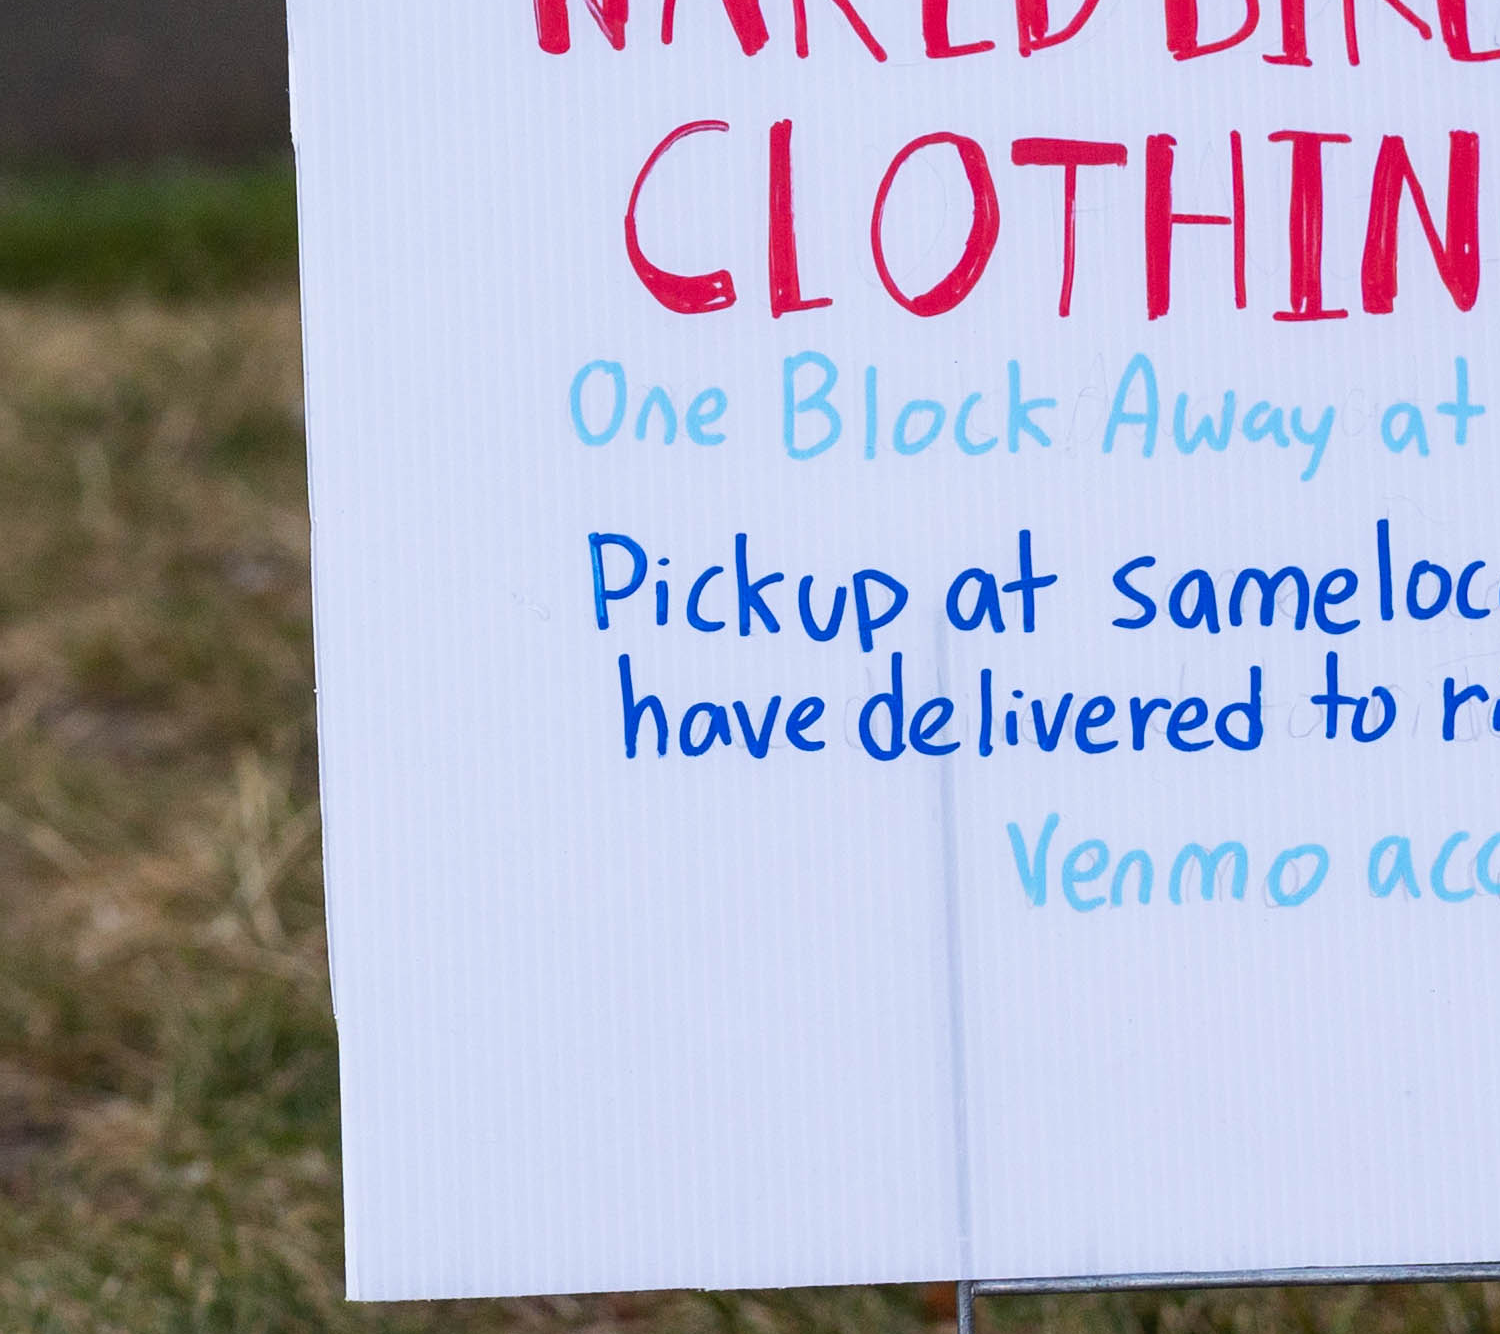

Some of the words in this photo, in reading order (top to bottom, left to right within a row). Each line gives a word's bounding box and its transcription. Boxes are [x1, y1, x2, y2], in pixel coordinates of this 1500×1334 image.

[568, 358, 730, 448] One
[781, 349, 1058, 463] Block
[1100, 351, 1338, 484] Away
[1379, 354, 1488, 459] at
[585, 529, 911, 655] Pickup
[943, 527, 1060, 636] at
[616, 651, 828, 762] have
[856, 649, 1266, 764] delivered
[1004, 810, 1332, 914] Venmo
